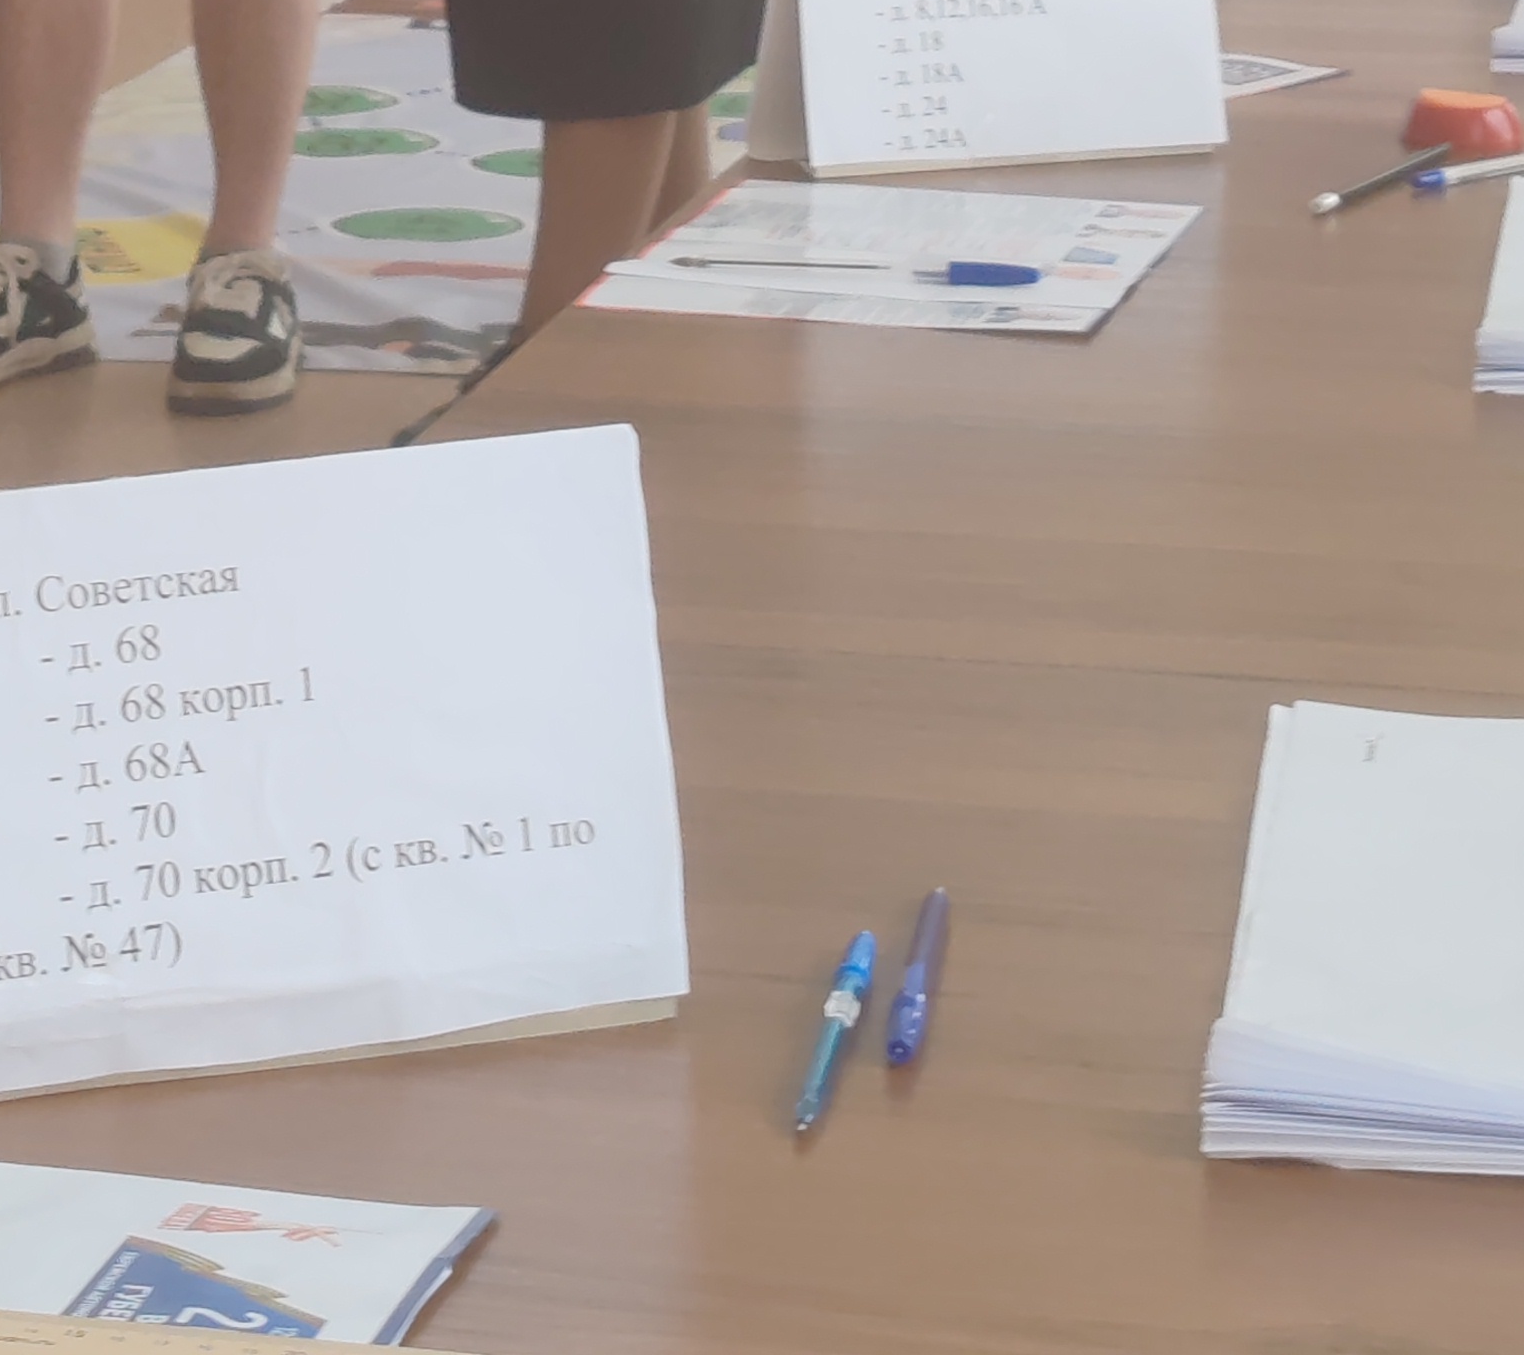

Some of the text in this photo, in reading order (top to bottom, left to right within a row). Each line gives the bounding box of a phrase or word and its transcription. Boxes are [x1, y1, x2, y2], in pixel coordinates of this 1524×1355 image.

[35, 566, 240, 613] Советская
[67, 642, 102, 673] д.
[115, 624, 161, 664] 68
[72, 702, 107, 732] д.
[120, 683, 167, 723] 68
[178, 681, 284, 722] корп.
[299, 666, 315, 702] 1
[77, 761, 112, 793] д.
[124, 740, 207, 782] 68А
[81, 821, 117, 852] д.
[130, 801, 176, 842] 70
[86, 881, 122, 911] д.
[134, 860, 181, 901] 70
[193, 857, 300, 899] корп.
[310, 841, 334, 879] 2
[345, 837, 381, 883] (с
[393, 839, 449, 868] кв.
[460, 821, 506, 860] №
[519, 816, 534, 852] 1
[548, 819, 595, 849] по
[60, 932, 108, 973] №
[118, 921, 184, 968] 47)
